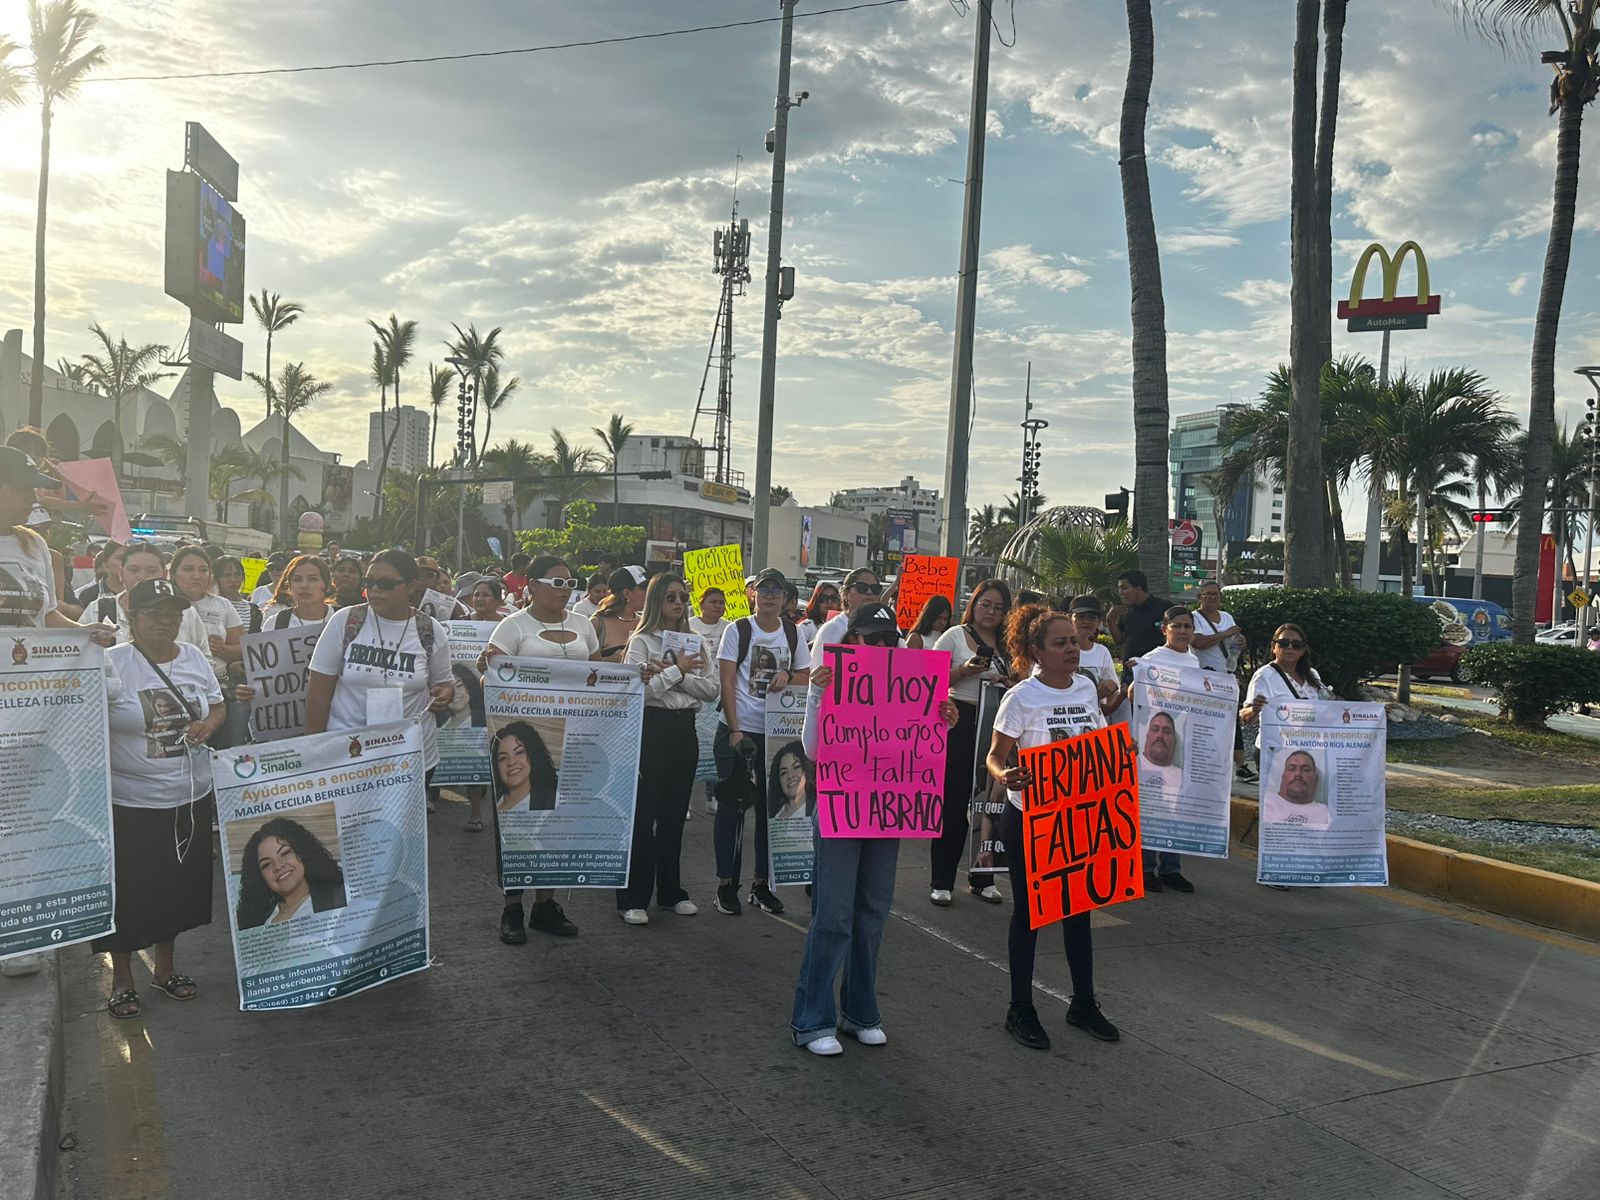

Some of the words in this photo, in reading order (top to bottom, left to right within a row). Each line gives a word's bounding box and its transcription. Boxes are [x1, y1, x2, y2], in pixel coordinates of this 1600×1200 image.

[1366, 318, 1408, 327] AutoMac
[686, 548, 741, 574] Cecilia
[904, 556, 948, 576] Bebe
[452, 630, 477, 638] Sinaloa
[32, 645, 80, 654] SINALOA
[246, 641, 279, 672] NO
[71, 677, 80, 688] a
[518, 673, 549, 684] Sinaloa
[887, 649, 938, 716] hoy
[44, 694, 84, 706] FLORES
[499, 691, 556, 706] Ayúdanos
[489, 704, 519, 714] MARÍA
[521, 706, 550, 716] CECILIA
[553, 708, 599, 717] BERRELLEZA
[600, 710, 628, 718] FLORES
[1164, 703, 1189, 713] ANTONIO
[1291, 714, 1315, 722] Sinaloa
[365, 734, 404, 746] SINALOA
[895, 719, 945, 759] años
[1300, 740, 1328, 748] ANTONIO
[1330, 740, 1345, 748] RÍOS
[260, 760, 302, 775] Sinaloa
[819, 761, 855, 787] me
[1020, 728, 1135, 812] HERMANA
[242, 779, 314, 803] Ayúdanos
[319, 777, 327, 787] a
[331, 763, 397, 785] encontrar
[401, 761, 409, 770] a
[235, 801, 272, 818] MARÍA
[275, 794, 313, 810] CECILIA
[315, 782, 374, 802] BERRELLEZA
[376, 773, 413, 788] FLORES
[819, 790, 860, 832] TU
[869, 790, 944, 833] ABRAZO
[1029, 790, 1136, 874] FALTAS
[539, 861, 559, 869] ayuda
[46, 897, 67, 908] esta
[71, 889, 109, 904] persona,
[22, 915, 34, 924] es
[36, 911, 57, 920] muy
[259, 974, 285, 985] tienes
[289, 961, 338, 979] información
[290, 995, 304, 1004] 327
[305, 991, 324, 1000] 8424
